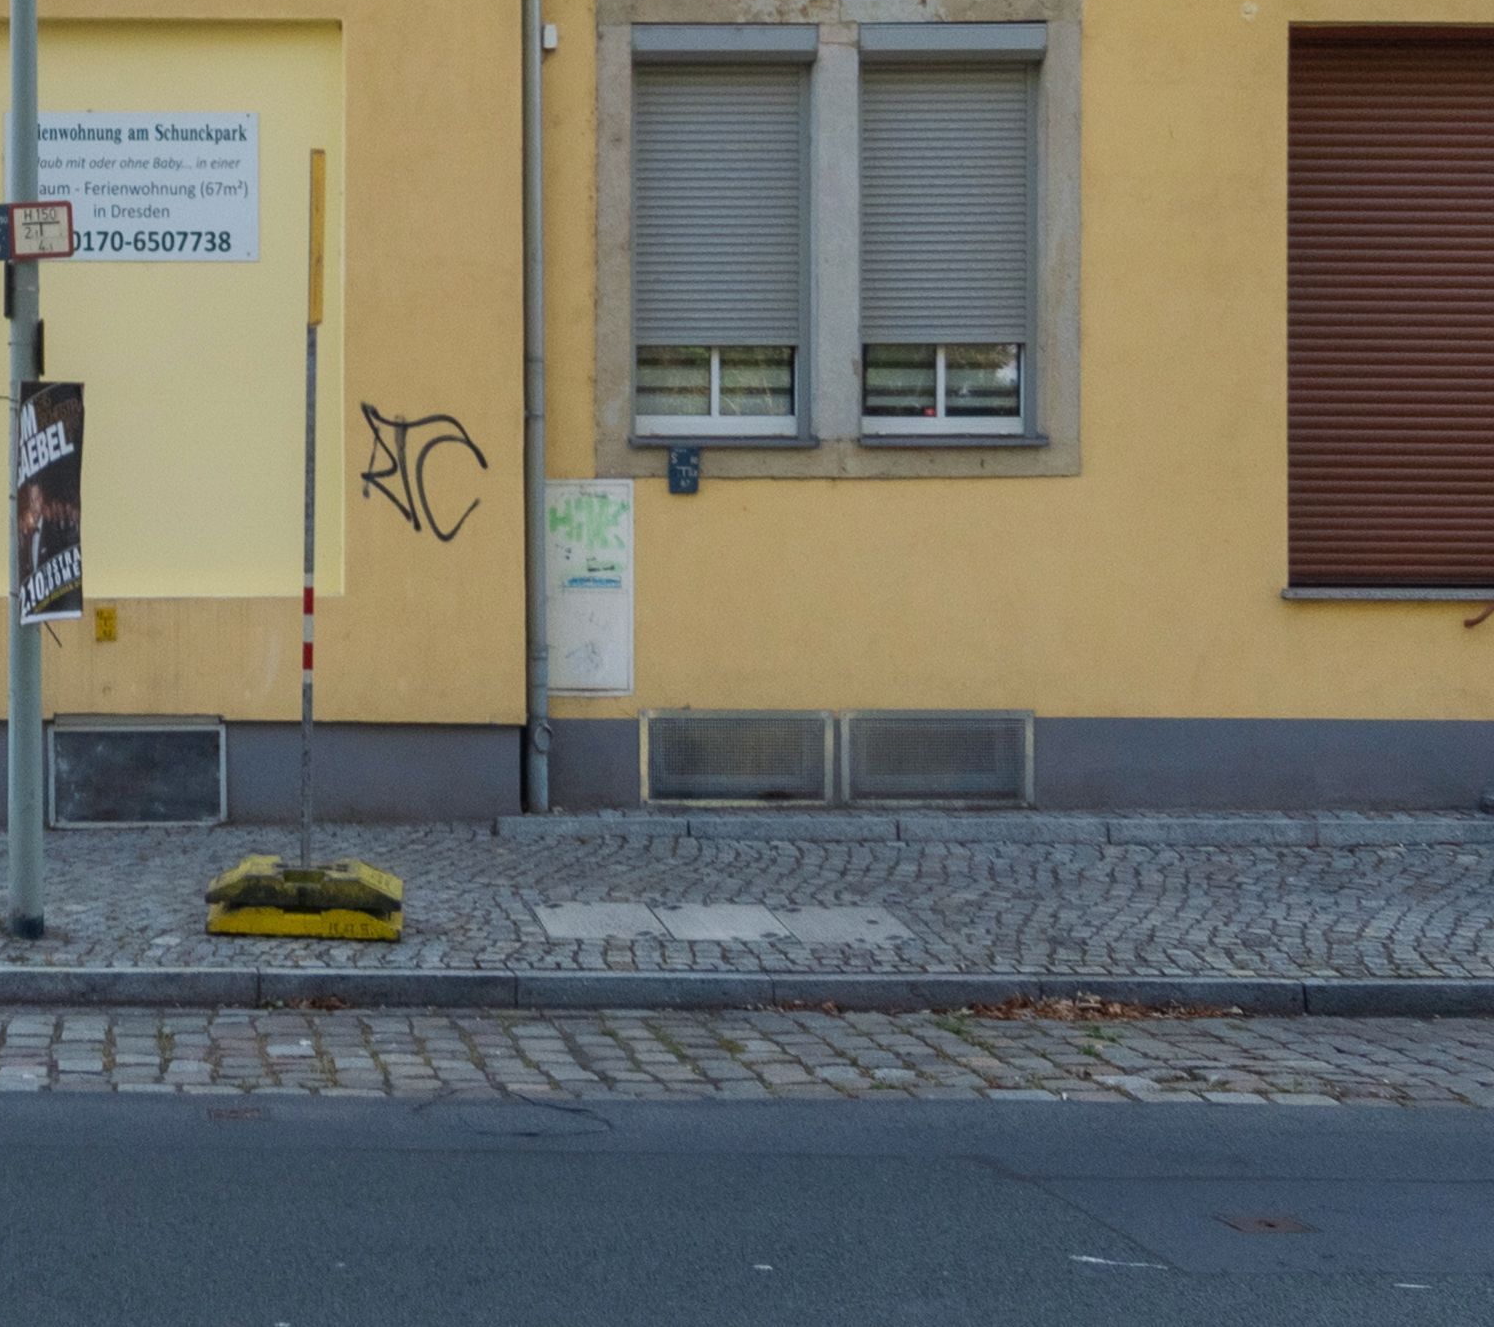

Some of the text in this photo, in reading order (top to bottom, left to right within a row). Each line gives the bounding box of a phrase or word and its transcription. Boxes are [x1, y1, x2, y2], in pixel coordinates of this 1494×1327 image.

[38, 123, 248, 144] ienwohnung am Schunckpark
[38, 157, 62, 170] laub
[66, 157, 85, 170] mit
[89, 156, 115, 170] oder
[120, 156, 149, 170] ohne
[196, 157, 207, 170] in
[211, 157, 241, 170] einer
[39, 184, 70, 196] aum
[84, 181, 196, 198] Ferienwohnung
[200, 180, 248, 198] (67m²)
[23, 208, 57, 220] H 150
[94, 204, 170, 218] in Dresden
[18, 419, 74, 485] AEBEL
